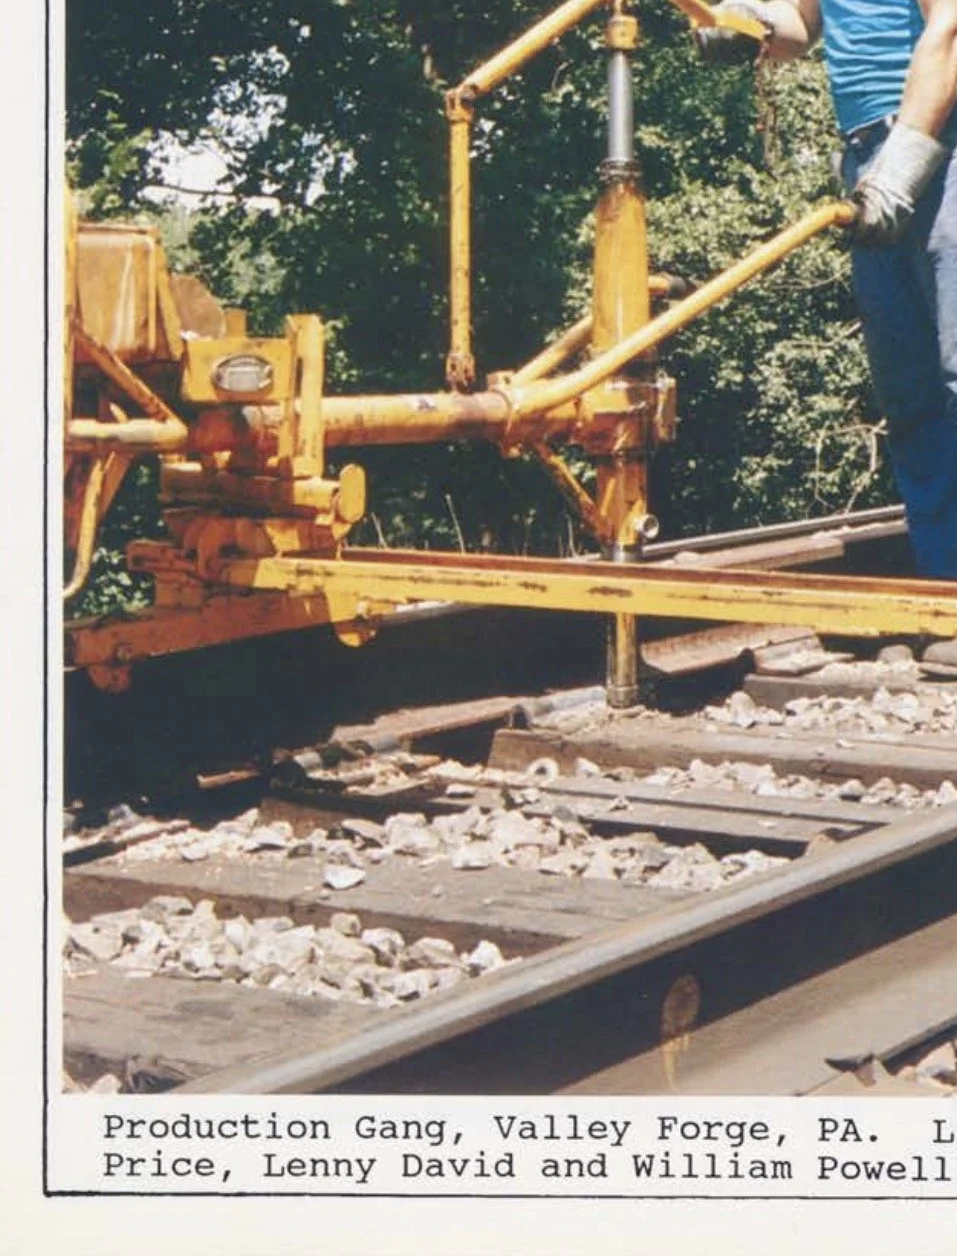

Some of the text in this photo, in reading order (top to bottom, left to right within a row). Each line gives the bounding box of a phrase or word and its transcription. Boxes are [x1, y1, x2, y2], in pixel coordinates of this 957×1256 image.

[104, 1111, 330, 1140] Production
[355, 1115, 462, 1147] Gang,
[493, 1114, 631, 1147] Valley
[658, 1116, 785, 1148] Forge,
[818, 1117, 878, 1142] PA.
[103, 1149, 231, 1183] Price,
[263, 1153, 377, 1184] Lenny
[402, 1150, 516, 1178] David
[541, 1153, 608, 1178] and
[632, 1151, 793, 1179] William
